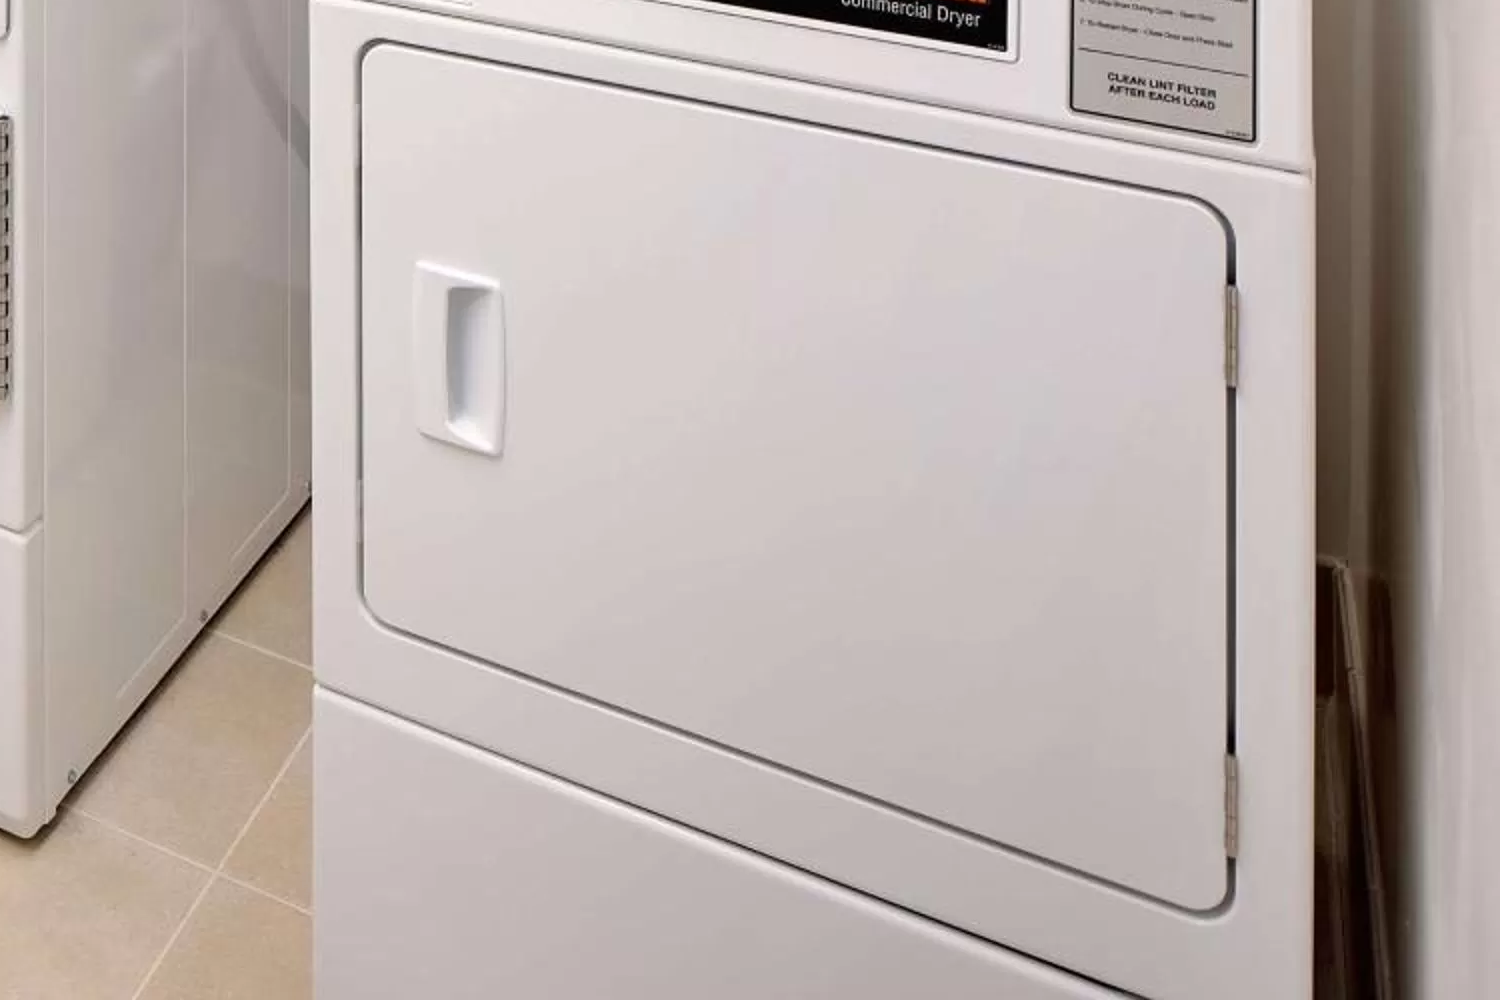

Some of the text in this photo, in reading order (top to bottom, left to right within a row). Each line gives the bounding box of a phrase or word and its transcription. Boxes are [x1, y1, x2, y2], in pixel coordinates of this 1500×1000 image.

[937, 4, 981, 28] Dryer
[1107, 71, 1217, 99] CLEAN LINT FILTER
[1108, 85, 1216, 111] AFTER EACH LOAD
